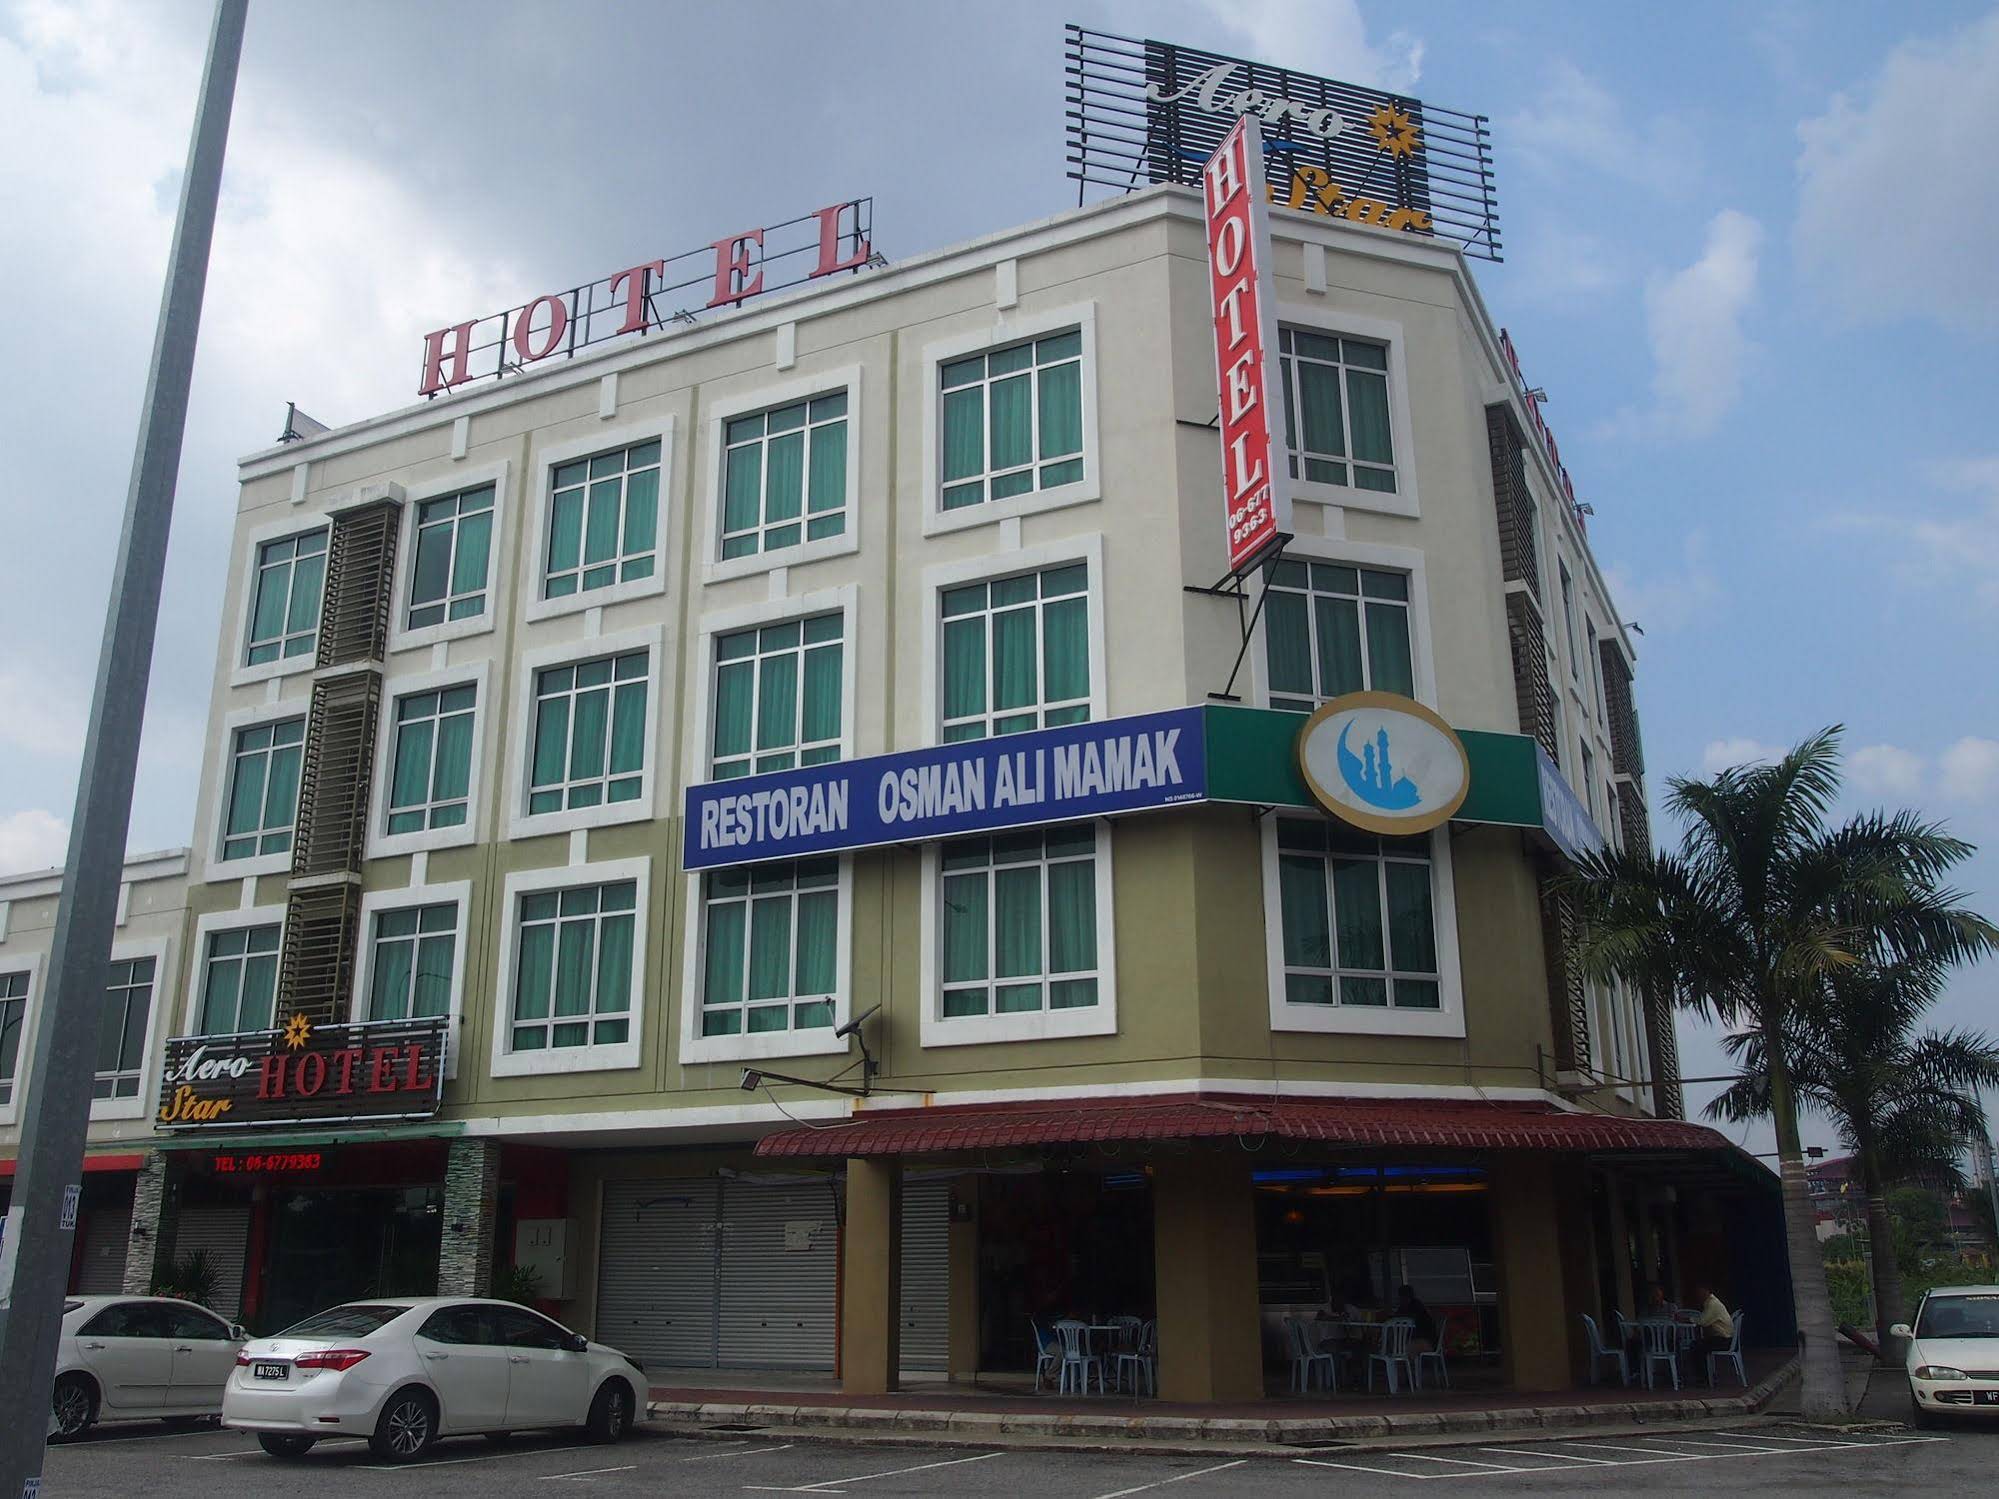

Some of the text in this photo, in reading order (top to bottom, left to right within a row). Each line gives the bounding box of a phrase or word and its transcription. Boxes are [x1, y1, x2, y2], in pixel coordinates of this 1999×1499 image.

[1146, 62, 1356, 138] Aero
[1266, 165, 1433, 231] Star
[418, 202, 871, 396] HOTEL
[1206, 136, 1263, 500] HOTEL
[1229, 483, 1270, 529] 06-677
[1233, 508, 1268, 544] 9363
[700, 728, 1183, 849] RESTORAN OSMAN ALI MAMAK
[165, 1044, 254, 1082] Aero
[256, 1044, 434, 1099] HOTEL
[160, 1084, 233, 1122] Star
